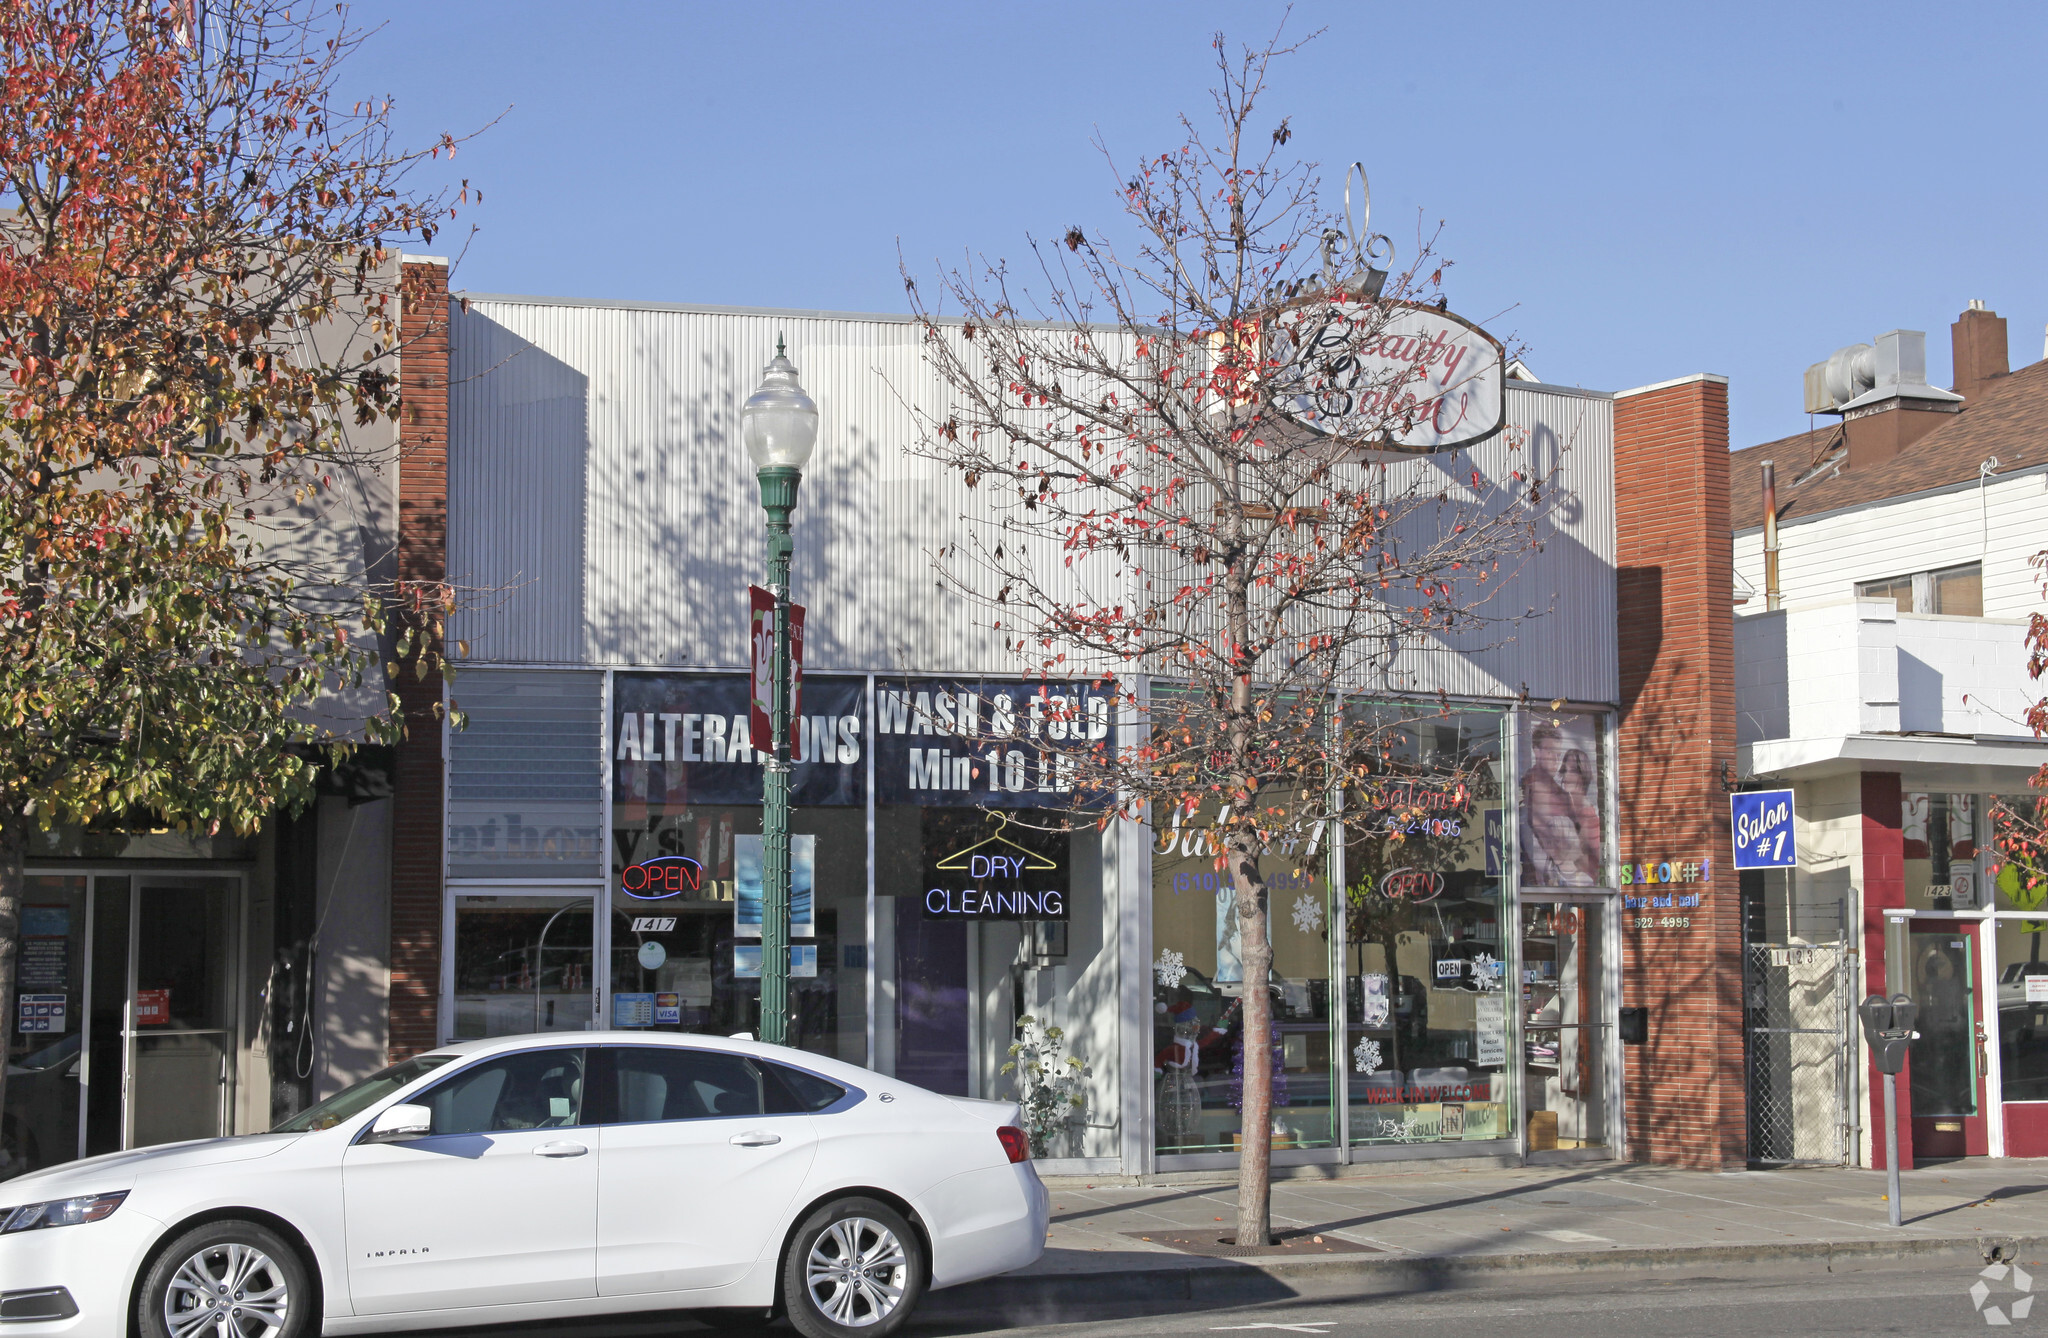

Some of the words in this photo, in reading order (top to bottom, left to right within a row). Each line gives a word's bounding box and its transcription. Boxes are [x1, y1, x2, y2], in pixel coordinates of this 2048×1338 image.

[876, 690, 979, 737] WASH
[991, 693, 1017, 739] &
[616, 711, 860, 764] ALTERAONS
[909, 748, 970, 790] Min
[986, 749, 1025, 792] 10
[1736, 800, 1789, 849] Salon
[1755, 830, 1788, 861] #1
[623, 865, 701, 891] OPEN
[971, 855, 1025, 878] DRY
[1173, 872, 1221, 895] (510)
[1388, 872, 1436, 898] OPEN
[1926, 885, 1951, 896] 1423
[926, 888, 1063, 914] CLEANING
[1624, 894, 1648, 909] hair
[1652, 893, 1673, 909] and
[1679, 892, 1700, 907] nail
[635, 918, 676, 930] 1417
[1775, 950, 1814, 964] 1423
[1438, 962, 1460, 976] OPEN
[660, 1010, 678, 1018] VISA
[1480, 1056, 1504, 1064] Available
[1366, 1086, 1425, 1104] WALK-IN
[1428, 1084, 1491, 1101] WELCOME
[367, 1247, 430, 1258] IMPALA
